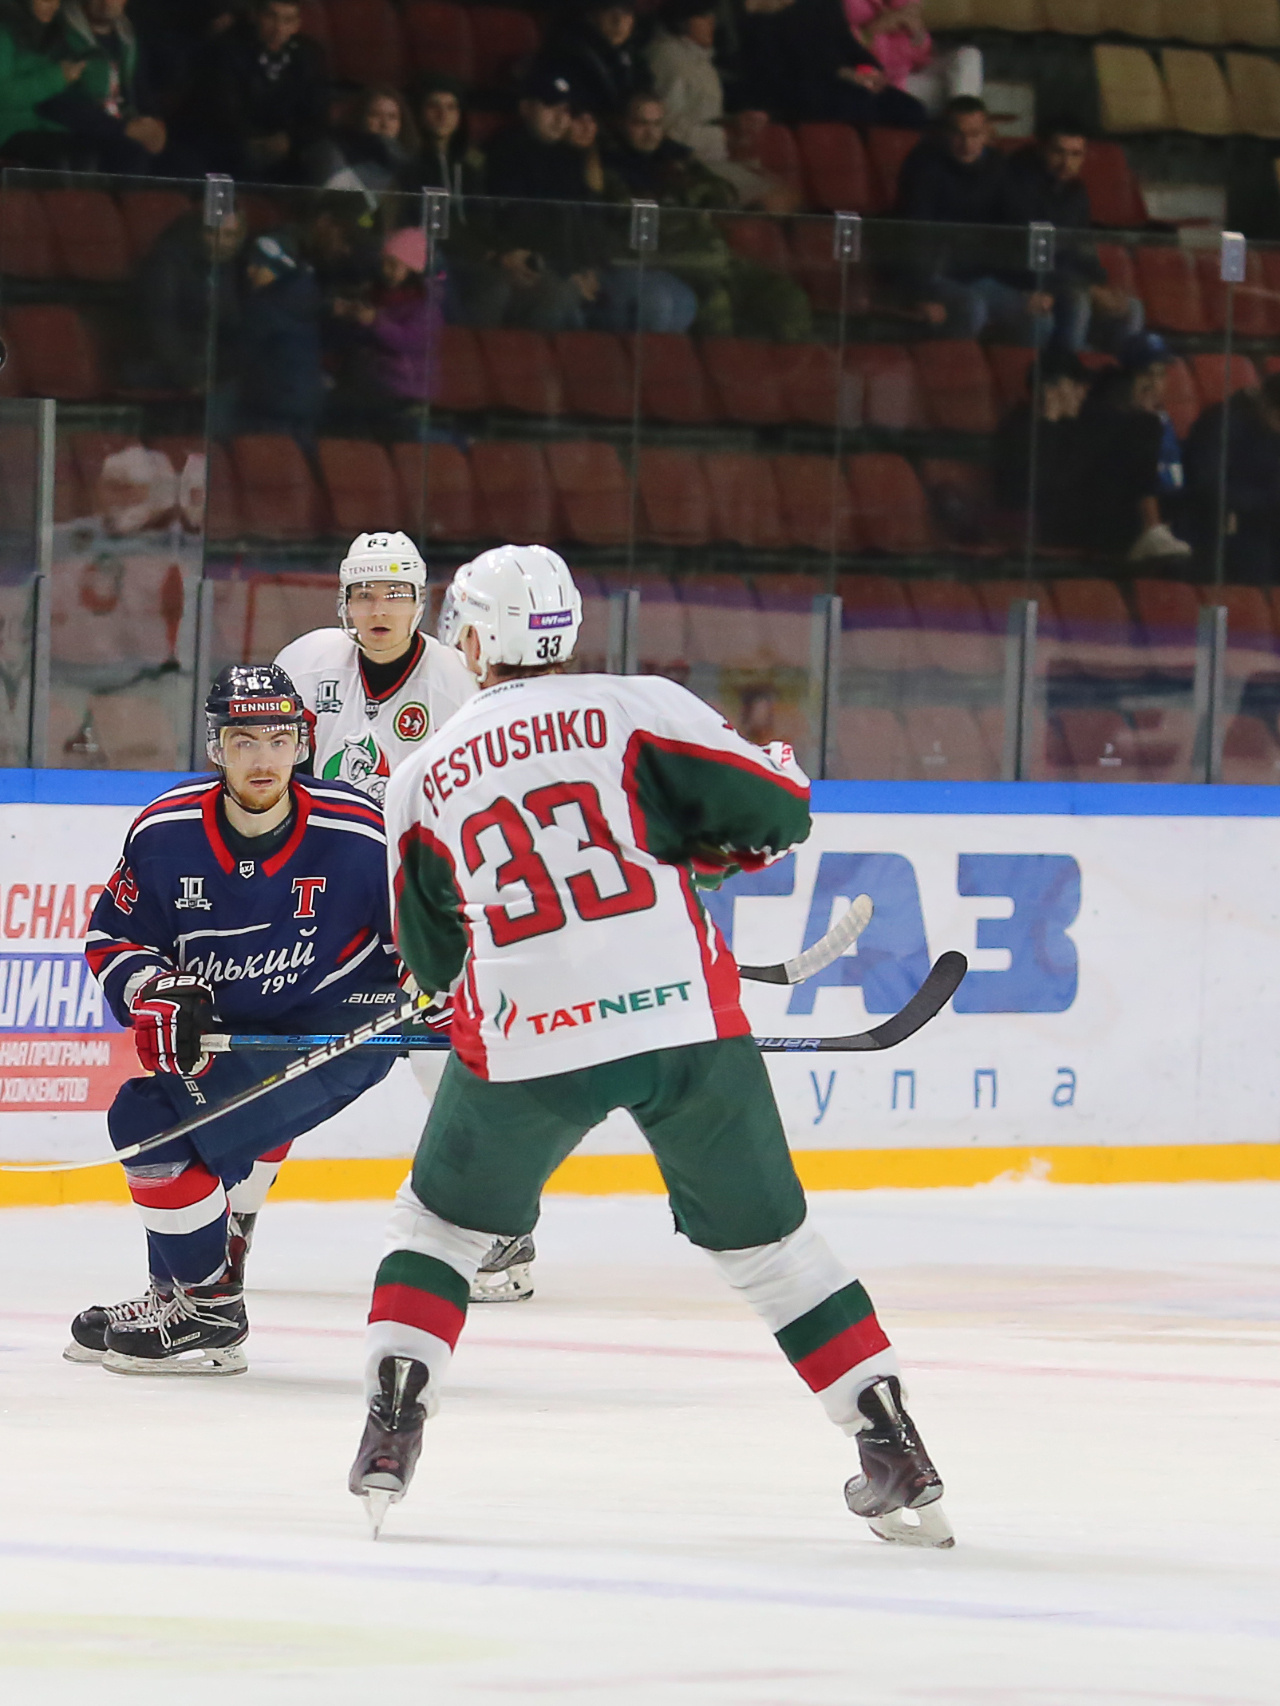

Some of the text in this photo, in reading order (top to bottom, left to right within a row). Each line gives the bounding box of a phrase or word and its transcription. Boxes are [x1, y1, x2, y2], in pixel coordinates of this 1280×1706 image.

[348, 565, 387, 575] TENNISI
[536, 635, 562, 659] 33
[233, 703, 280, 713] TENNISI
[423, 708, 607, 817] PESTUSHKO
[461, 781, 656, 947] 33
[156, 975, 213, 992] BAU
[342, 992, 397, 1004] AUER
[527, 981, 691, 1034] TATNEFT
[754, 1037, 821, 1048] AUER
[811, 1067, 1077, 1125] уппа
